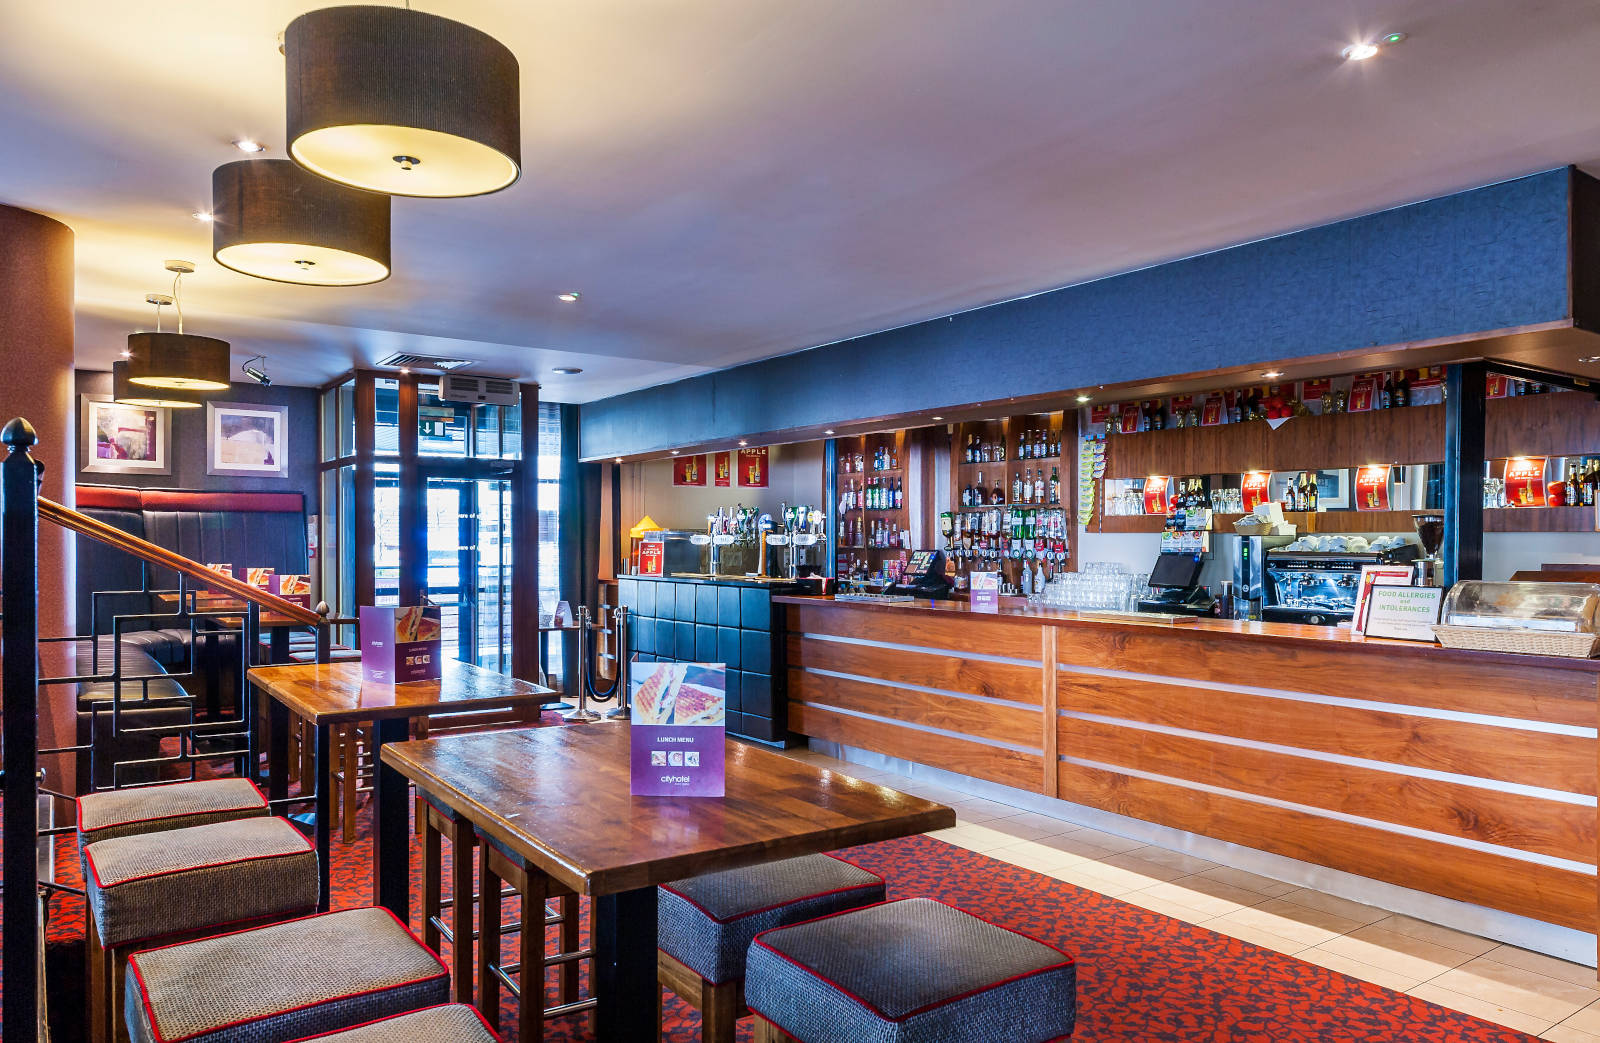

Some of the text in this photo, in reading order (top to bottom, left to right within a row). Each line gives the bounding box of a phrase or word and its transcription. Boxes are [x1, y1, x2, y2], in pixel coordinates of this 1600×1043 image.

[1398, 592, 1436, 600] ALLERGIES
[1379, 604, 1430, 612] INTOLERANCES
[661, 776, 690, 784] cityhotel
